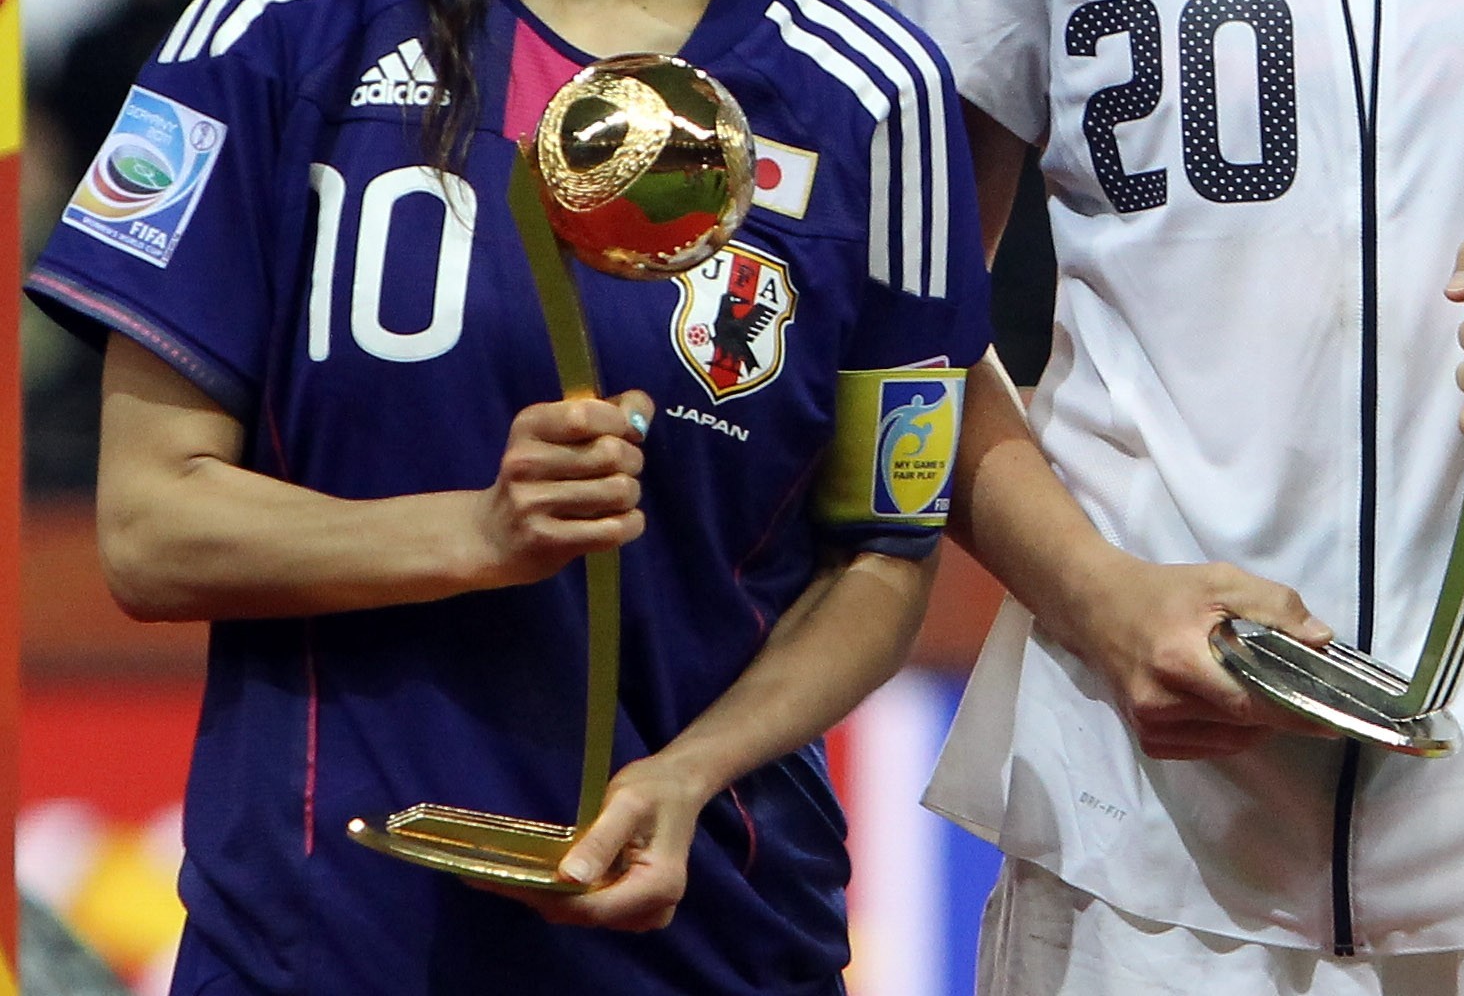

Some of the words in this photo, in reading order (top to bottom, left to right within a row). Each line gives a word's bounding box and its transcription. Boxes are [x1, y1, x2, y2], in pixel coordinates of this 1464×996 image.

[129, 221, 169, 249] FIFA
[308, 162, 478, 363] 10
[666, 405, 750, 442] JAPAN
